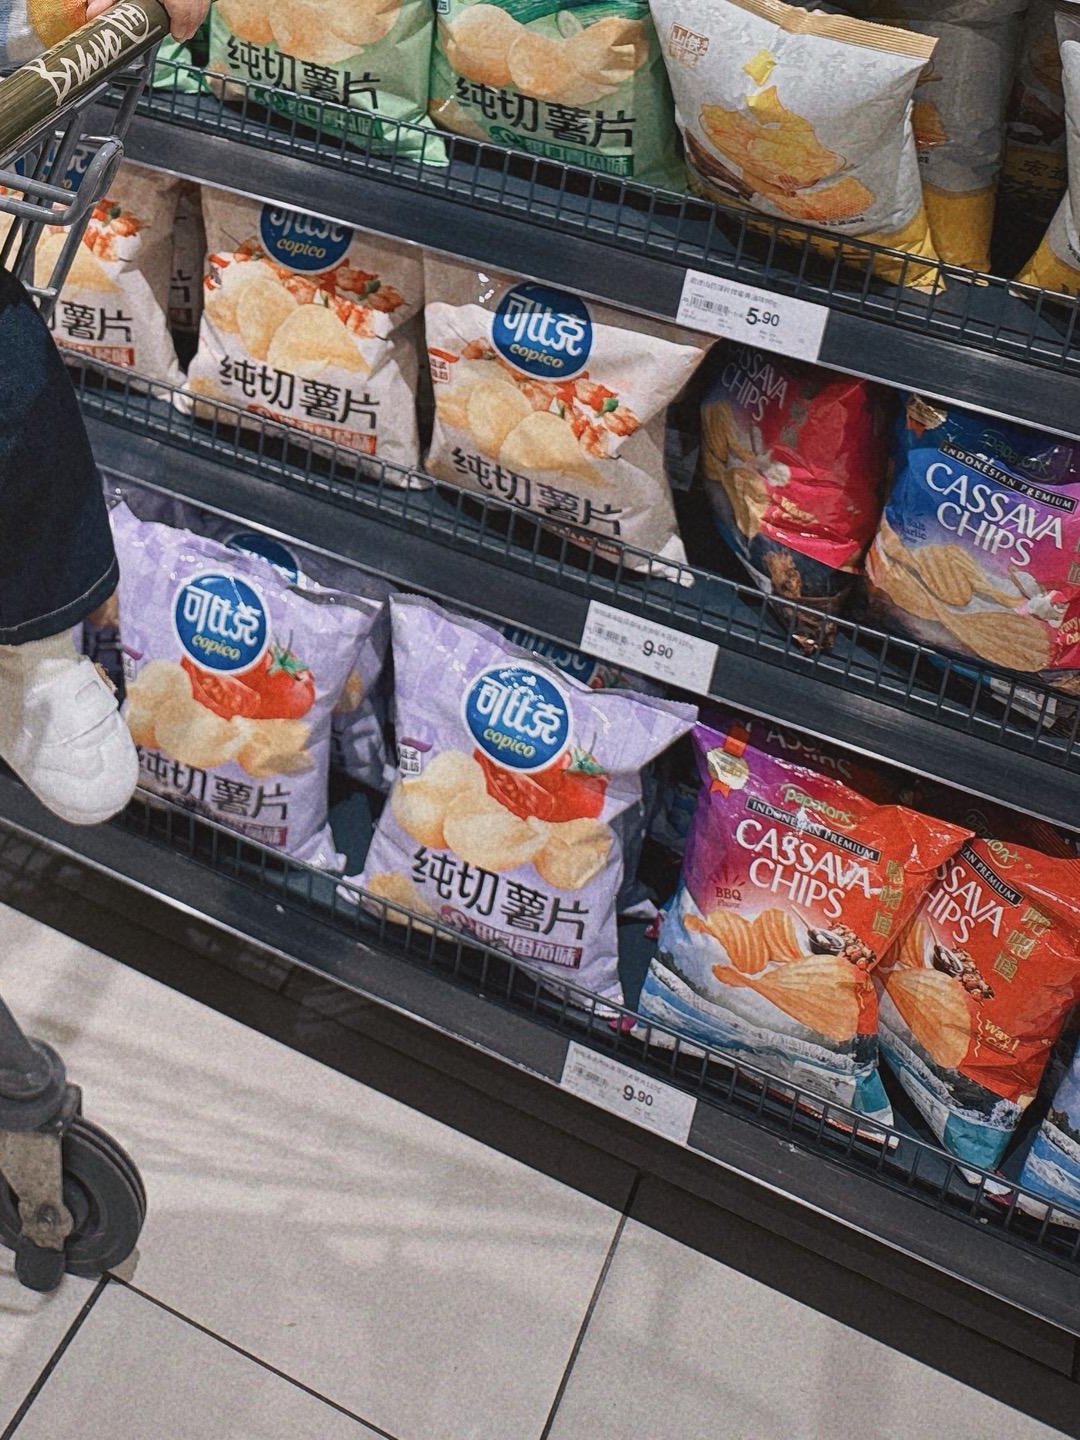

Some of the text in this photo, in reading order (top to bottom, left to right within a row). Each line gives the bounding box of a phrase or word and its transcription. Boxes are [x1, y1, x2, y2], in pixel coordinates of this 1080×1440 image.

[228, 35, 381, 110] 纯切薯片
[456, 78, 636, 148] 纯切薯片
[276, 237, 327, 259] copico
[504, 293, 586, 357] 可比克
[746, 307, 780, 326] 5.90
[510, 344, 564, 368] copico
[220, 355, 380, 429] 纯切薯片
[452, 447, 622, 535] 纯切薯片
[926, 462, 1062, 549] CASSAVA
[942, 443, 1073, 510] INDONESIAN PREMIUM
[937, 502, 1034, 566] CHIPS
[184, 586, 263, 646] 可比克
[191, 634, 240, 661] copico
[642, 640, 673, 660] 9.90
[477, 676, 563, 744] 可比克
[483, 728, 537, 758] copico
[736, 819, 874, 898] CASSAVA
[751, 800, 875, 861] INDONESIAN PREMIUM
[412, 848, 590, 939] 纯切薯片
[715, 887, 742, 901] BBQ
[749, 857, 845, 918] CHIPS
[976, 859, 1017, 903] PREMIUM
[622, 1085, 653, 1106] 9.90
